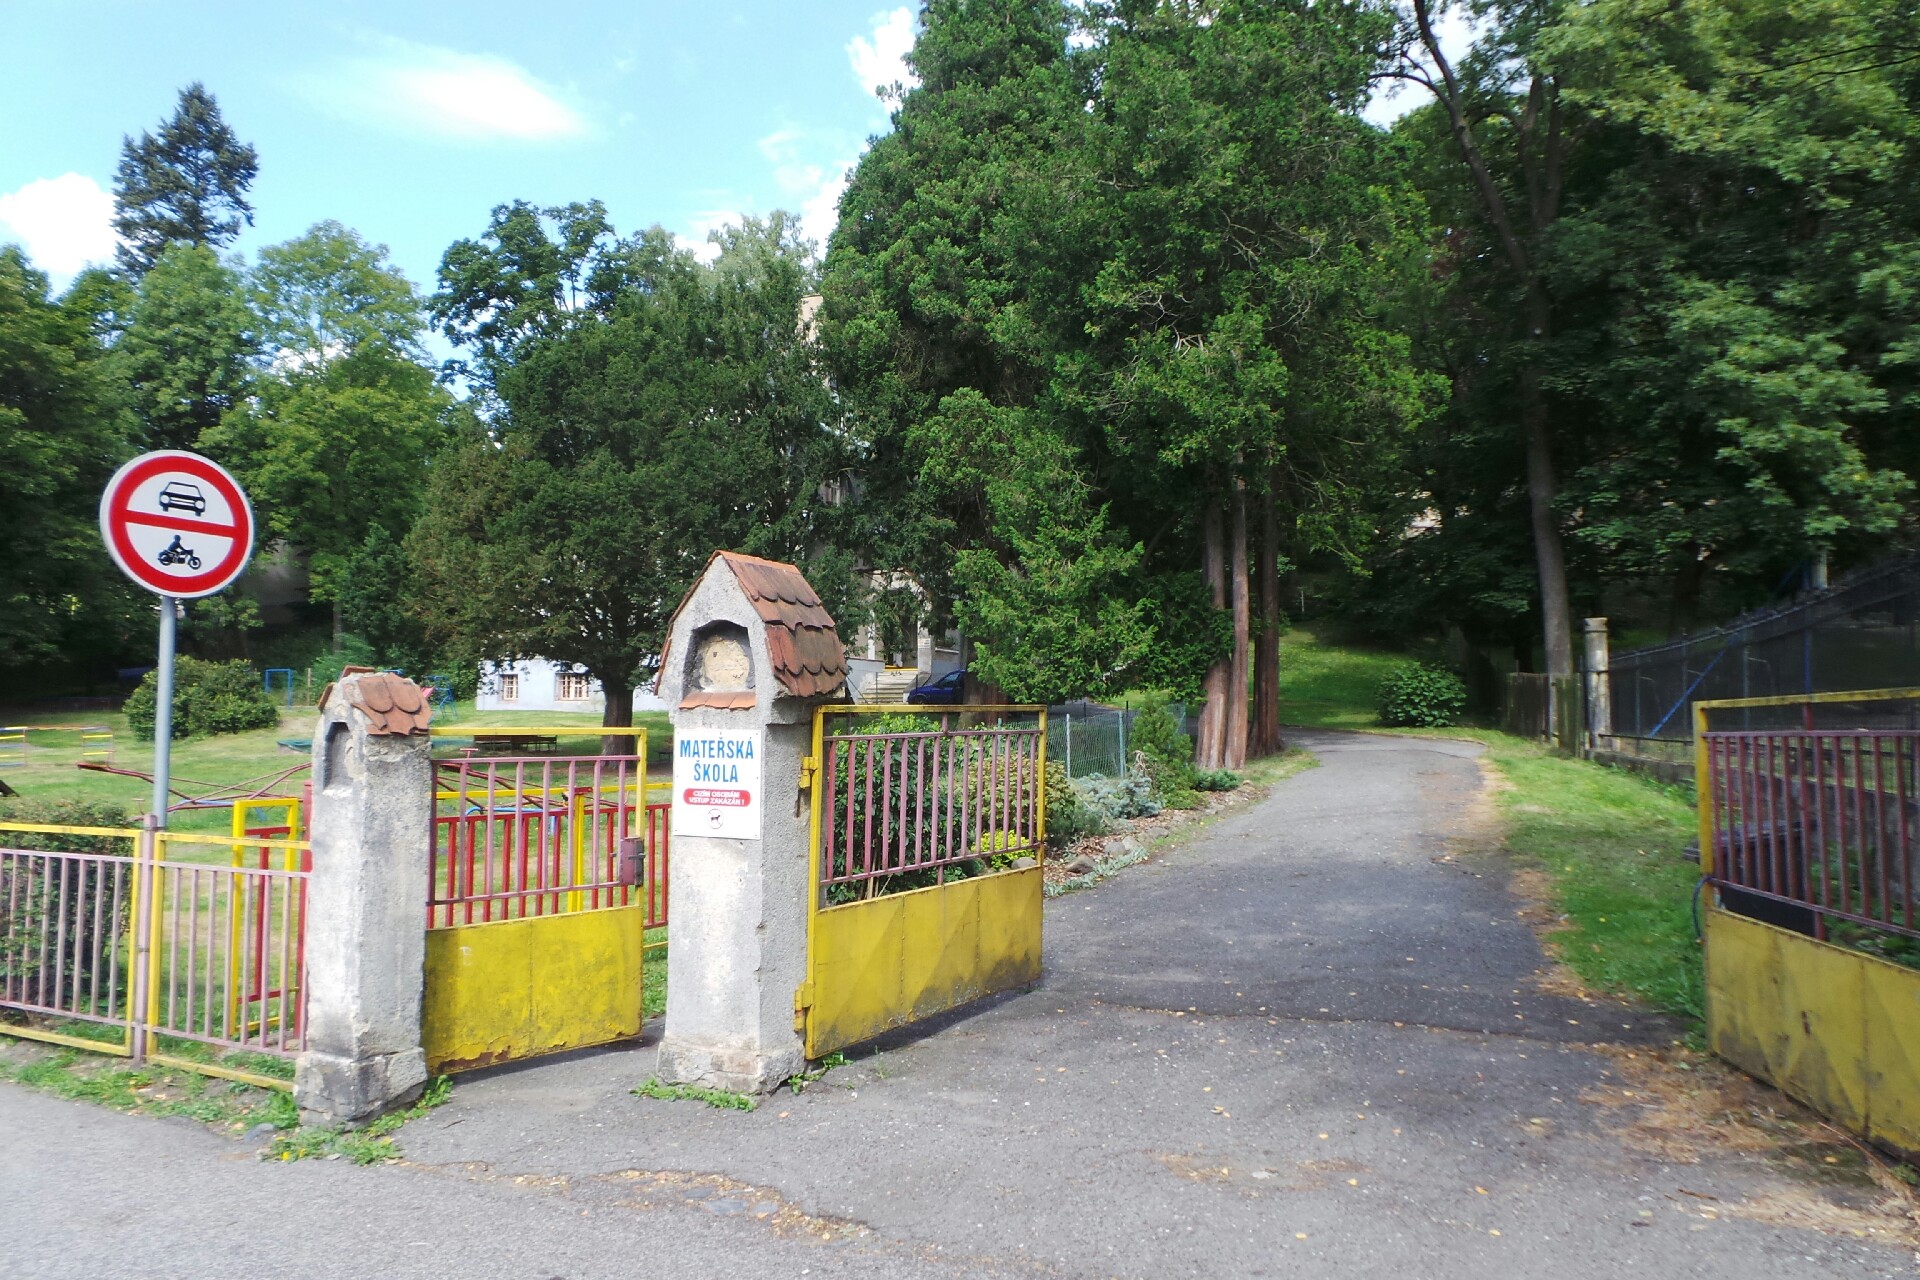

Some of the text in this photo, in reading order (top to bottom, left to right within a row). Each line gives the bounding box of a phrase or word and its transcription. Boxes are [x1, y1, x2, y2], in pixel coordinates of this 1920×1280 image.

[680, 737, 754, 759] MATEŘSKÁ
[694, 760, 738, 782] ŠKOLA
[693, 789, 740, 798] CIZÍM OSOBÁM
